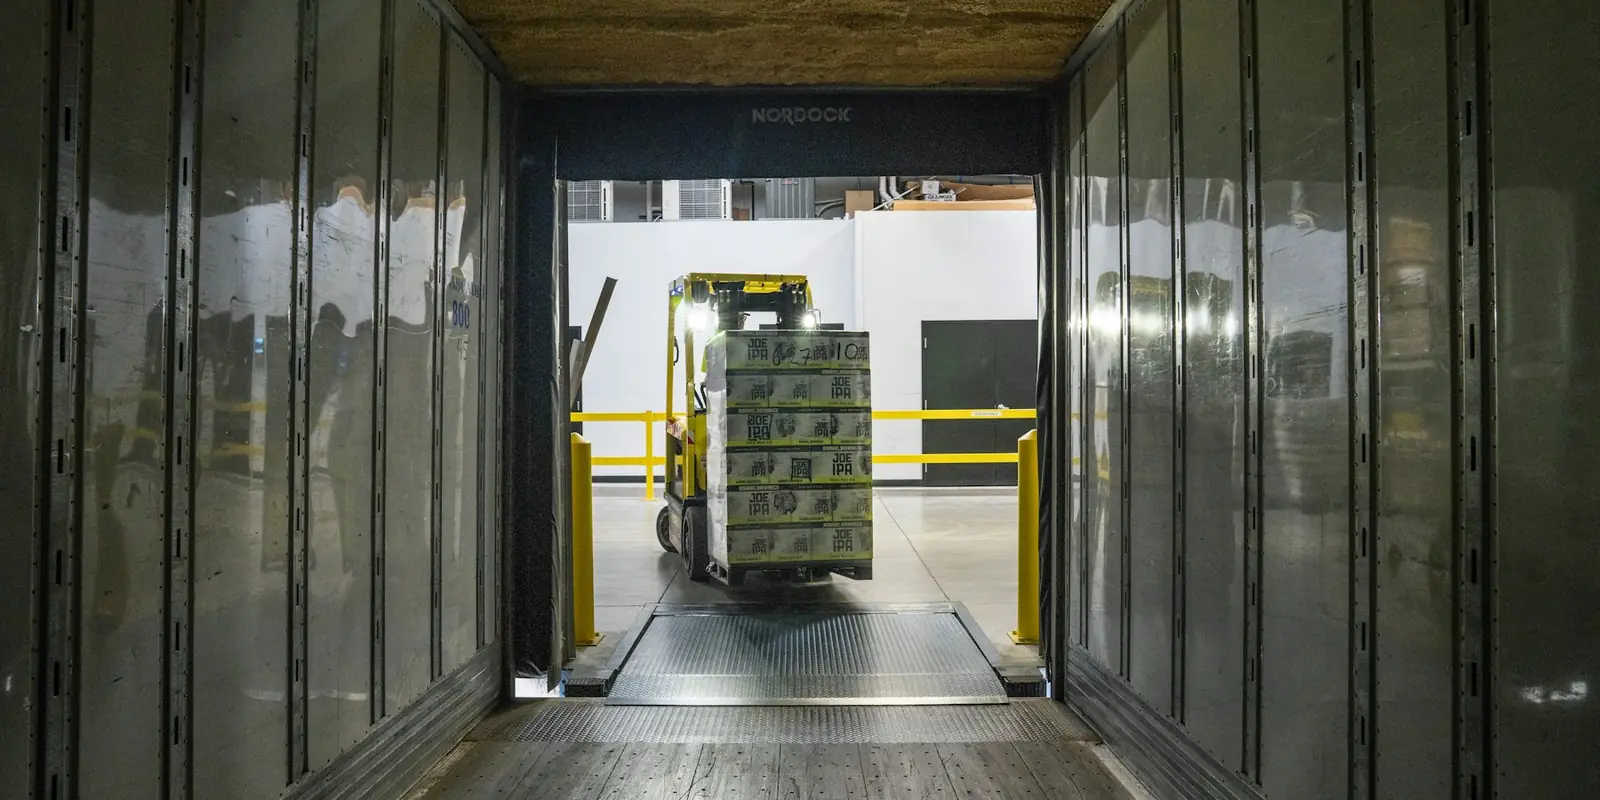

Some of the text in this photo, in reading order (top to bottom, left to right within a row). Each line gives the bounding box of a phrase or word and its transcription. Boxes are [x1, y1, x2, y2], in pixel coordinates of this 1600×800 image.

[752, 107, 852, 125] NORDOCK
[452, 300, 470, 329] 800
[748, 338, 768, 348] JOE
[748, 349, 768, 360] IPA
[813, 352, 828, 360] IPA
[838, 342, 858, 360] 10
[832, 377, 850, 386] JOE
[752, 391, 765, 400] IPA
[794, 391, 808, 400] IPA
[832, 387, 851, 399] IPA
[814, 429, 828, 437] IPA
[833, 453, 851, 463] JOE
[752, 468, 766, 477] IPA
[794, 468, 808, 477] IPA
[833, 463, 852, 475] IPA
[749, 493, 768, 503] JOE
[749, 504, 769, 515] IPA
[815, 505, 828, 514] IPA
[833, 529, 852, 539] JOE
[752, 544, 766, 555] IPA
[794, 545, 808, 553] IPA
[833, 540, 853, 552] IPA
